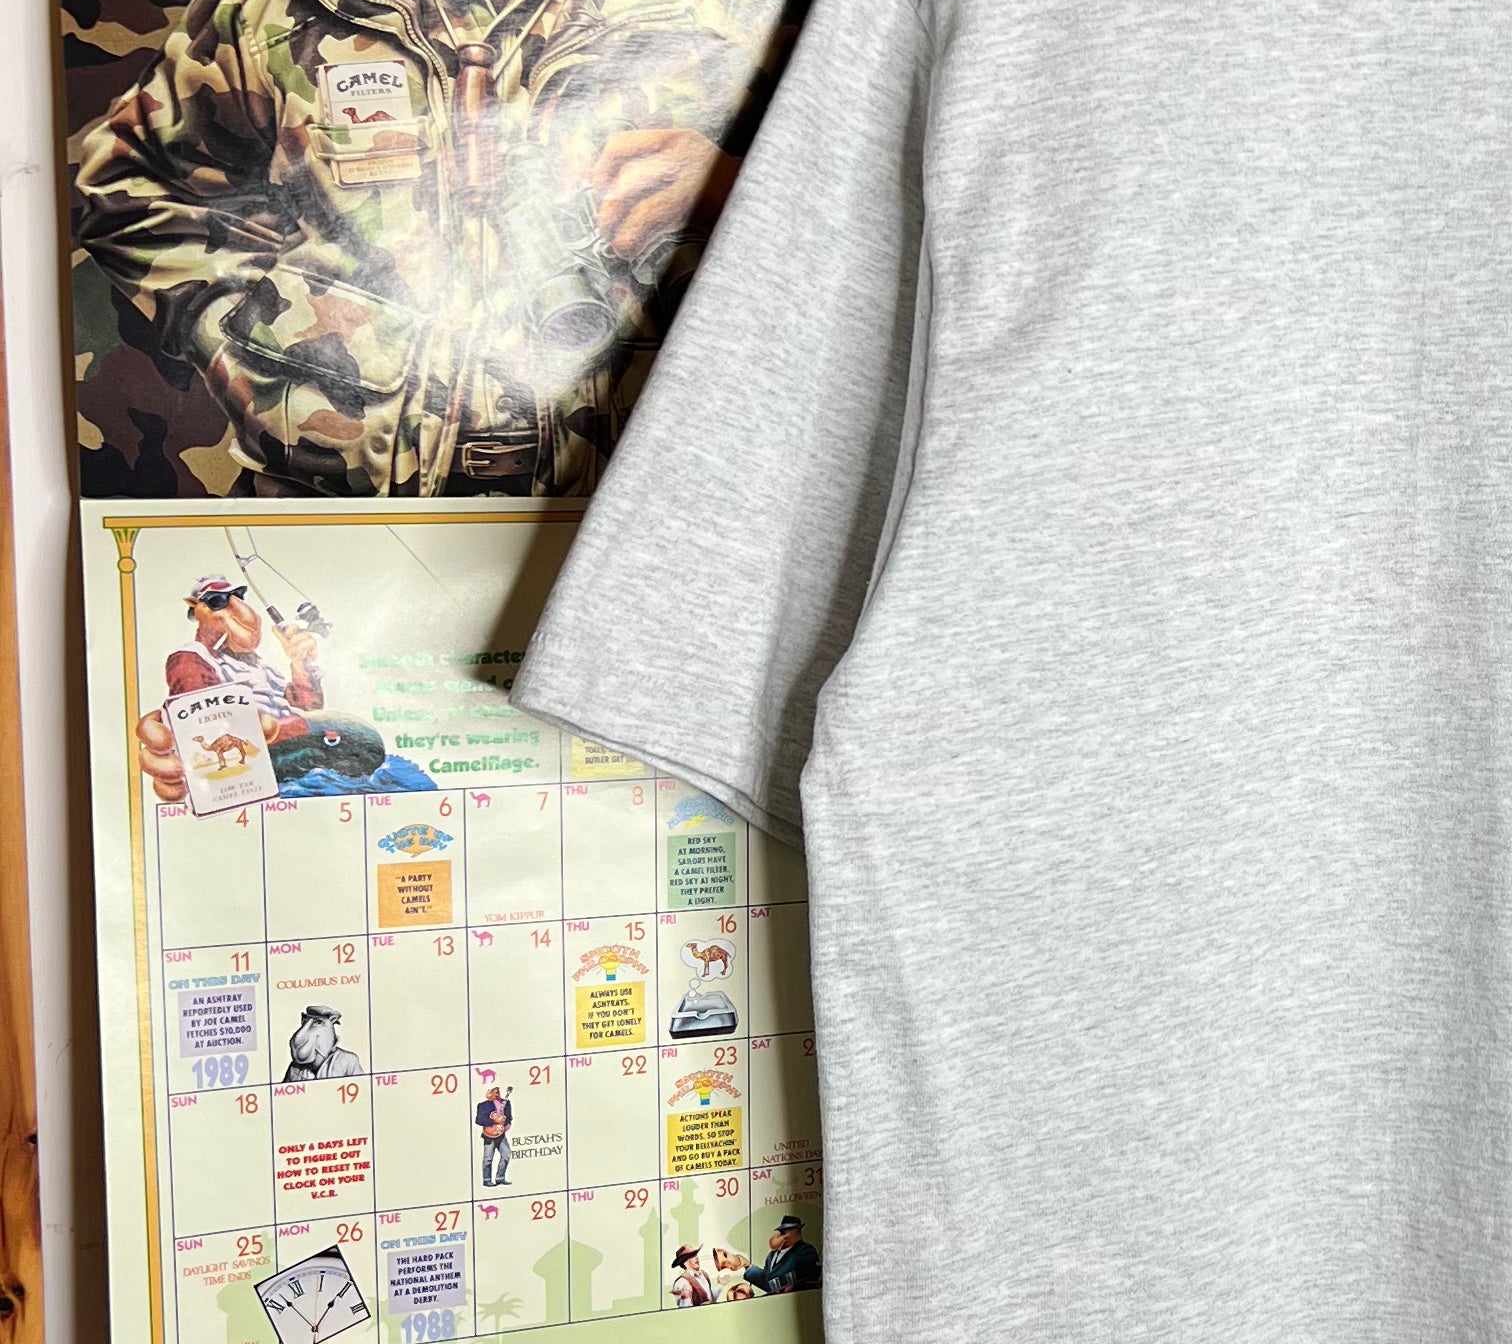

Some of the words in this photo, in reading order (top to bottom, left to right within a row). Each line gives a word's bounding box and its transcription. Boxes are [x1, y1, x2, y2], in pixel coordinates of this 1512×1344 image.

[337, 73, 403, 93] CAMEL
[350, 88, 392, 97] FILTERS
[177, 695, 249, 720] CAMEL
[395, 733, 460, 749] they're
[466, 728, 541, 745] wearing
[537, 791, 549, 811] 7
[564, 785, 588, 796] THU
[632, 786, 644, 805] 8
[265, 800, 298, 811] MON
[340, 802, 352, 823] 5
[368, 796, 391, 806] TUE
[440, 797, 452, 816] 6
[160, 807, 187, 817] SUN
[235, 808, 249, 828] 4
[408, 874, 432, 882] PARTY
[398, 885, 433, 893] WITHOUT
[700, 886, 724, 894] PREFER
[483, 914, 507, 923] YOM
[509, 910, 545, 921] KIPPUR
[750, 907, 772, 919] SAT
[566, 922, 590, 932] THU
[624, 921, 646, 941] 15
[660, 914, 677, 926] FRI
[717, 914, 737, 934] 16
[371, 936, 394, 947] TUE
[433, 936, 455, 956] 13
[530, 929, 552, 948] 14
[165, 951, 192, 963] SUN
[230, 952, 250, 972] 11
[269, 943, 301, 955] MON
[332, 944, 355, 964] 12
[277, 977, 338, 990] COLUMBUS
[341, 975, 361, 986] DAY
[207, 994, 242, 1004] ASHTRAY
[590, 990, 618, 999] ALWAYS
[183, 1006, 231, 1017] REPORTEDLY
[234, 1004, 253, 1012] USED
[204, 1017, 217, 1026] JOE
[220, 1015, 246, 1024] CAMEL
[187, 1028, 217, 1038] FETCHES
[751, 1038, 772, 1050] SAT
[661, 1048, 678, 1058] FRI
[713, 1046, 737, 1066] 23
[192, 1054, 249, 1089] 1989
[569, 1056, 592, 1068] THU
[621, 1056, 647, 1076] 22
[375, 1075, 398, 1086] TUE
[431, 1073, 458, 1095] 20
[529, 1065, 551, 1086] 21
[274, 1084, 306, 1096] MON
[337, 1083, 359, 1104] 19
[171, 1095, 197, 1108] SUN
[235, 1094, 259, 1115] 18
[680, 1112, 709, 1122] ACTIONS
[711, 1110, 732, 1118] SPEAK
[512, 1133, 563, 1146] BUSTAH'S
[718, 1129, 735, 1137] STOP
[278, 1144, 306, 1154] ONLY
[318, 1140, 343, 1150] DAYS
[346, 1137, 368, 1146] LEFT
[511, 1145, 563, 1159] BIRTHDAY
[675, 1144, 694, 1152] YOUR
[774, 1140, 809, 1151] UNITED
[286, 1157, 300, 1165] TO
[304, 1153, 337, 1163] FIGURE
[341, 1150, 361, 1159] OUT
[762, 1152, 804, 1164] NATIONS
[277, 1170, 302, 1179] HOW
[305, 1168, 318, 1176] TO
[322, 1164, 350, 1174] RESET
[353, 1161, 371, 1170] THE
[752, 1169, 773, 1181] SAT
[804, 1167, 823, 1187] 31
[283, 1180, 316, 1190] CLOCK
[319, 1178, 335, 1186] ON
[338, 1174, 365, 1184] YOUR
[663, 1180, 680, 1191] FRI
[715, 1177, 739, 1197] 30
[571, 1190, 594, 1202] THU
[624, 1188, 649, 1209] 29
[531, 1199, 557, 1220] 28
[379, 1213, 401, 1224] TUE
[435, 1210, 460, 1232] 27
[279, 1224, 310, 1236] MON
[336, 1221, 363, 1244] 26
[177, 1238, 203, 1251] SUN
[237, 1235, 264, 1257] 25
[381, 1239, 400, 1250] ON
[183, 1262, 228, 1276] DAYLIGHT
[232, 1256, 271, 1268] SAVINGS
[412, 1255, 433, 1264] HARD
[436, 1252, 454, 1260] PACK
[398, 1265, 437, 1275] PERFORMS
[440, 1262, 452, 1270] THE
[203, 1276, 226, 1286] TIME
[228, 1272, 252, 1283] ENDS
[390, 1276, 428, 1286] NATIONAL
[430, 1272, 461, 1282] ANTHEM
[394, 1289, 403, 1297] AT
[412, 1282, 458, 1294] DEMOLITION
[401, 1309, 455, 1344] 1988
